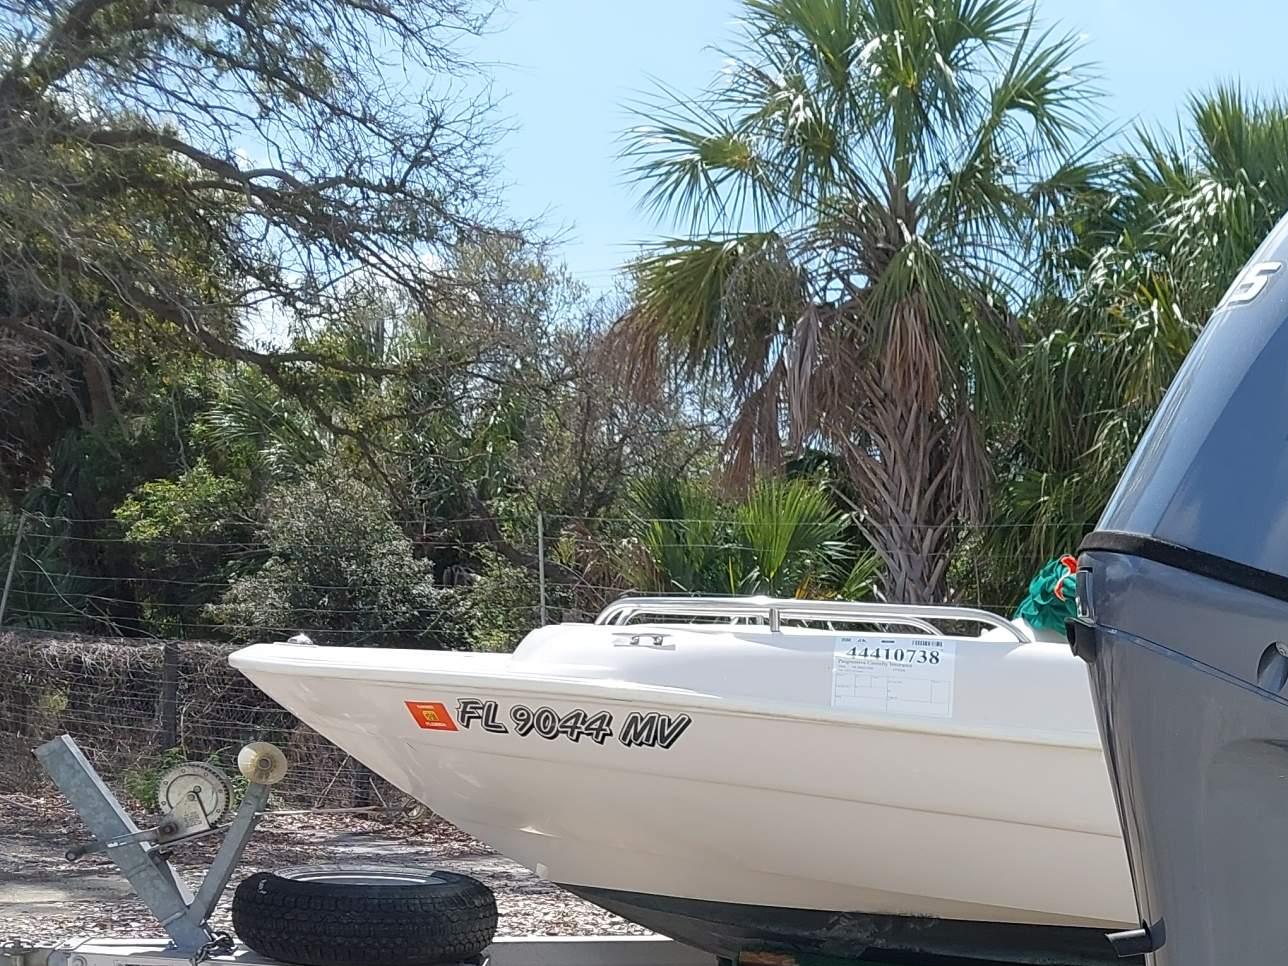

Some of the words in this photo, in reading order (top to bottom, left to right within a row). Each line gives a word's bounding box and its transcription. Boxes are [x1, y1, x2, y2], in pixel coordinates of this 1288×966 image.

[846, 646, 940, 665] 44410738
[456, 698, 508, 734] FL
[509, 705, 614, 744] 9044
[619, 712, 692, 749] MV
